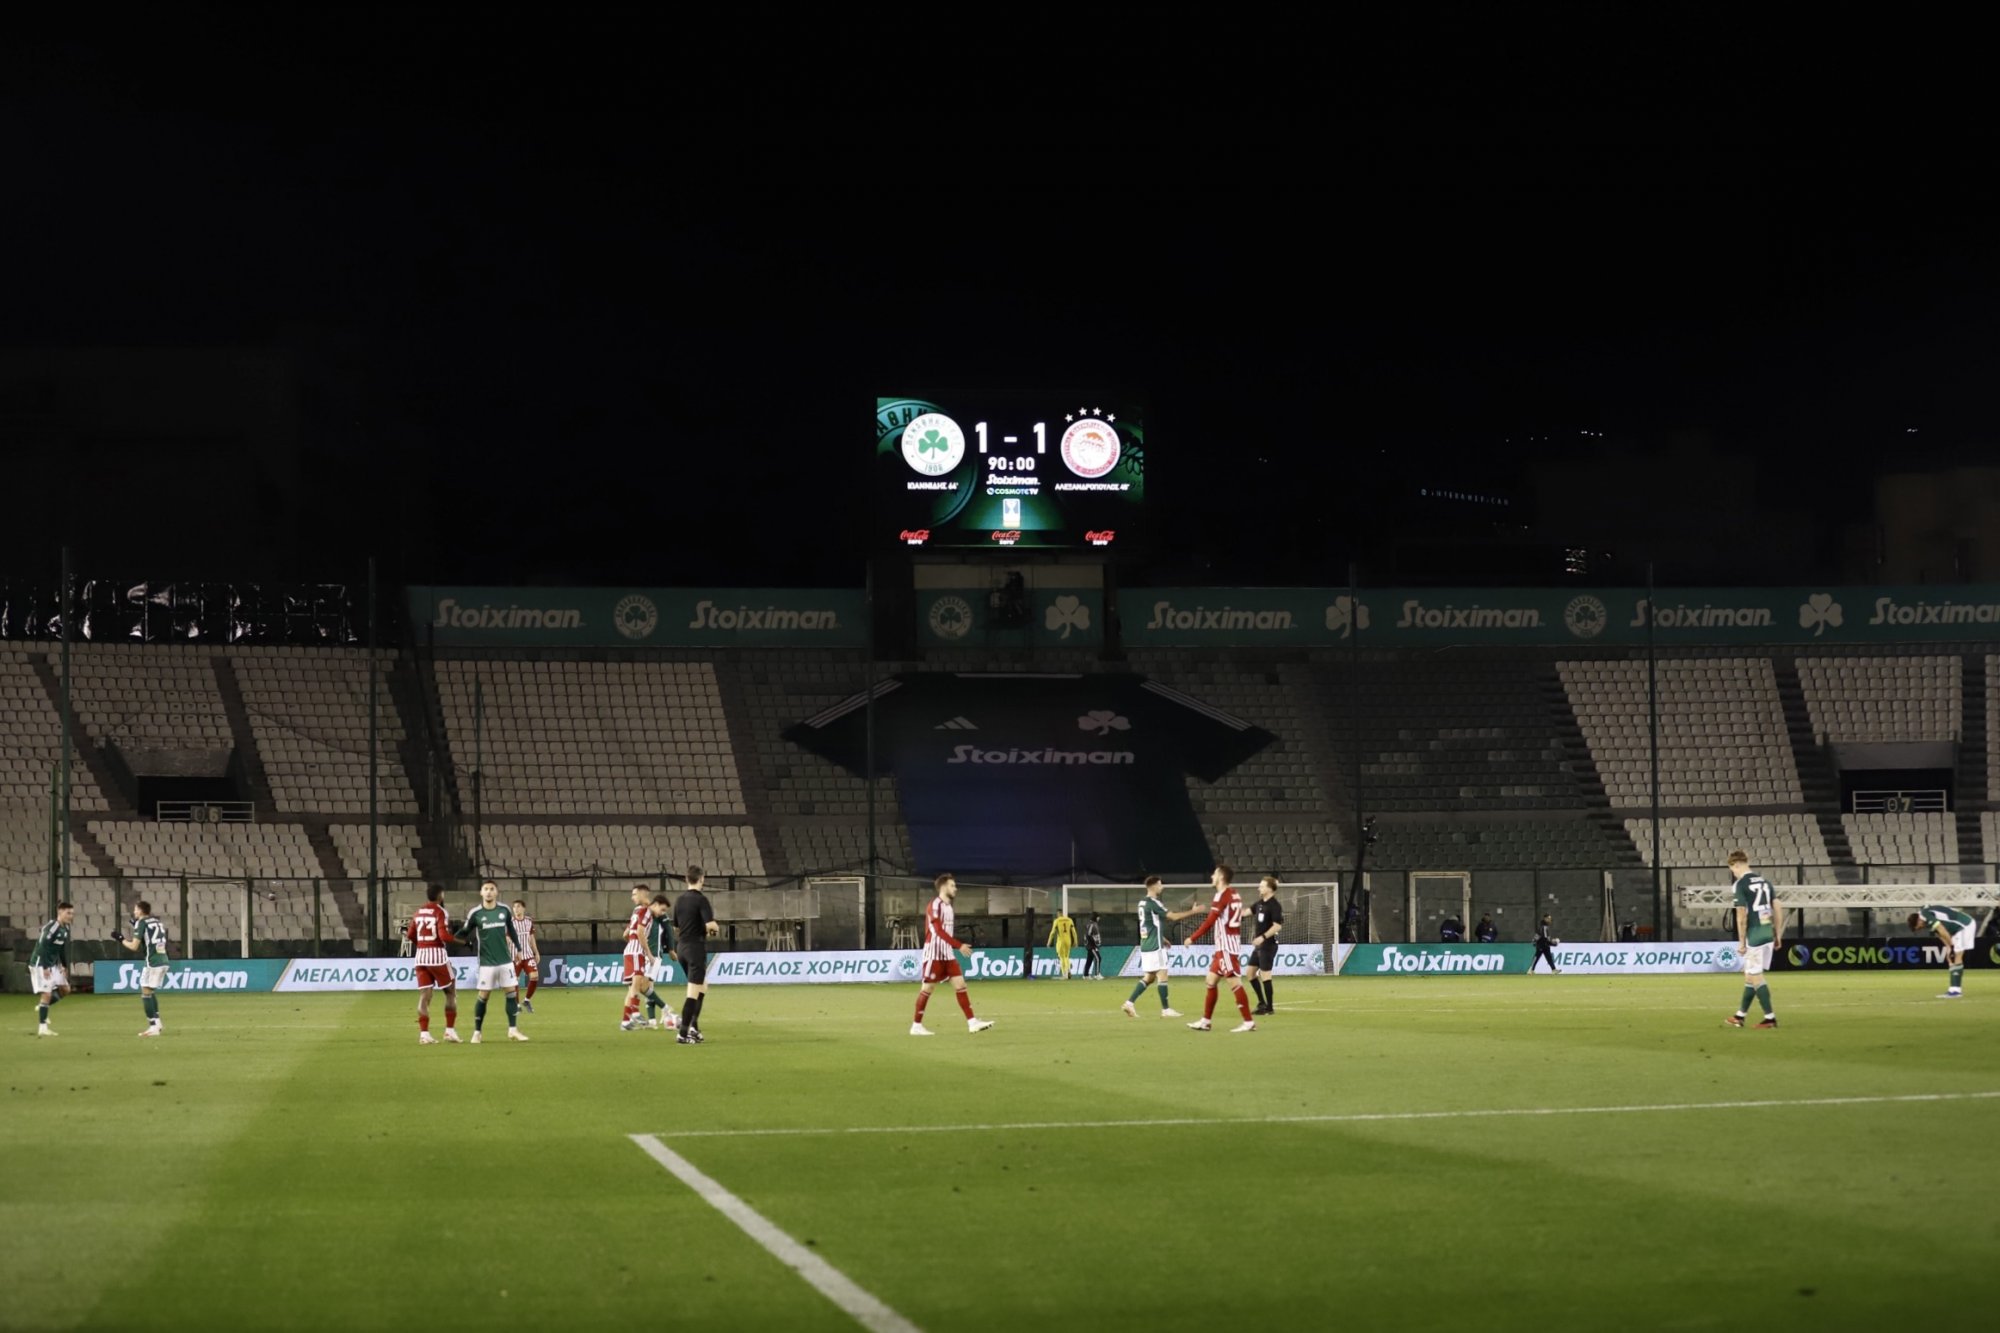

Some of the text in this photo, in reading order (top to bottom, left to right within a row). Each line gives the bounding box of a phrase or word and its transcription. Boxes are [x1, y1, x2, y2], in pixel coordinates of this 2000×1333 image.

[975, 421, 987, 453] 1
[1033, 422, 1046, 453] 1
[987, 456, 1035, 471] 90:00
[986, 473, 1039, 485] Stoiximan
[434, 599, 580, 628] Stoiximan
[690, 601, 836, 629] Stoiximan
[1147, 601, 1291, 629] Stoiximan
[1397, 600, 1538, 628] Stoiximan
[1630, 599, 1770, 627] Stoiximan
[947, 745, 1134, 764] Stoiximan
[1749, 883, 1772, 911] 21
[415, 917, 438, 941] 23
[717, 961, 803, 976] ΜΕΓΑΛΟΣ
[807, 959, 892, 975] ΧΟΡΗΓΟΣ
[1377, 946, 1505, 972] Stoiximan
[1633, 951, 1715, 965] ΧΟΡΗΓΟΣ
[1812, 946, 1948, 964] COSMOTE TV
[112, 963, 248, 990] Stximan
[293, 968, 380, 983] ΜΕΓΑΛΟΣ
[543, 958, 674, 984] Stoixin
